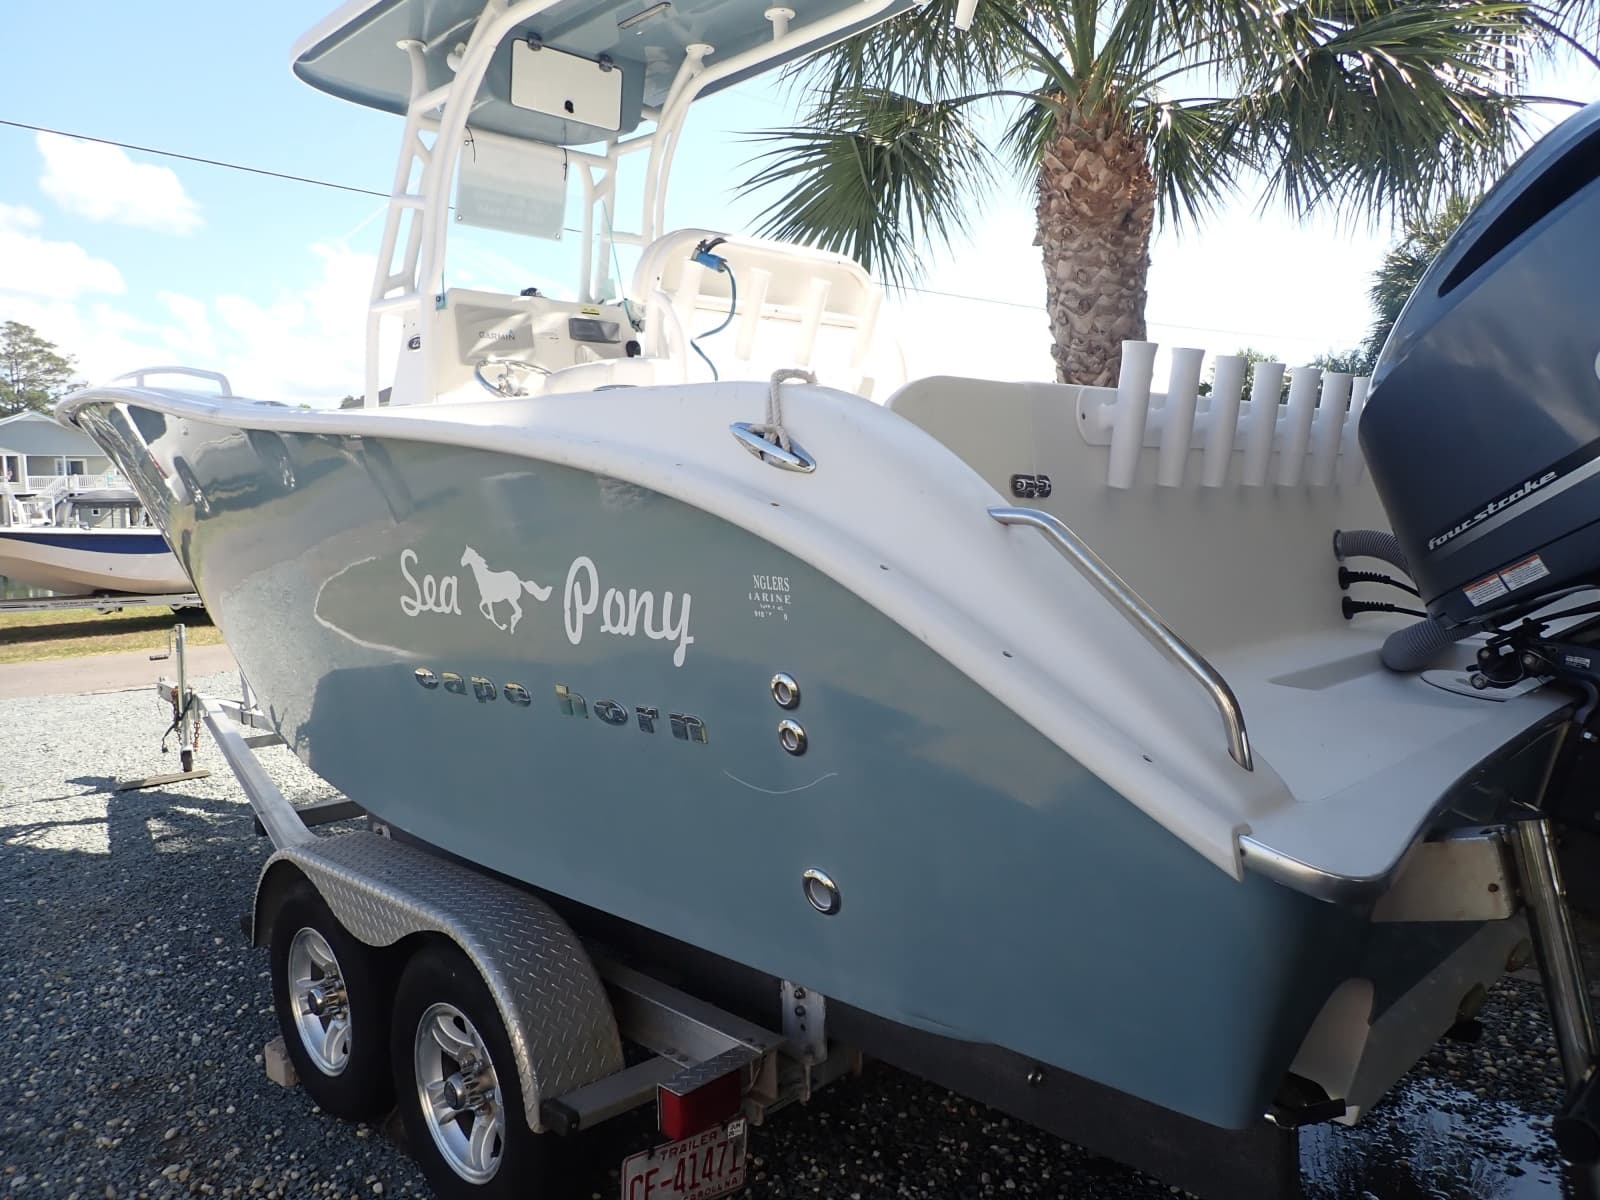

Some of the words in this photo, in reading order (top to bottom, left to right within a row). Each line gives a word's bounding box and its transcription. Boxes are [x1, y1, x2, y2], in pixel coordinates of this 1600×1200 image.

[400, 548, 462, 617] Sea
[563, 556, 694, 667] Pony
[414, 667, 532, 706] cape
[555, 682, 709, 745] horn
[658, 1130, 718, 1160] TRAILER
